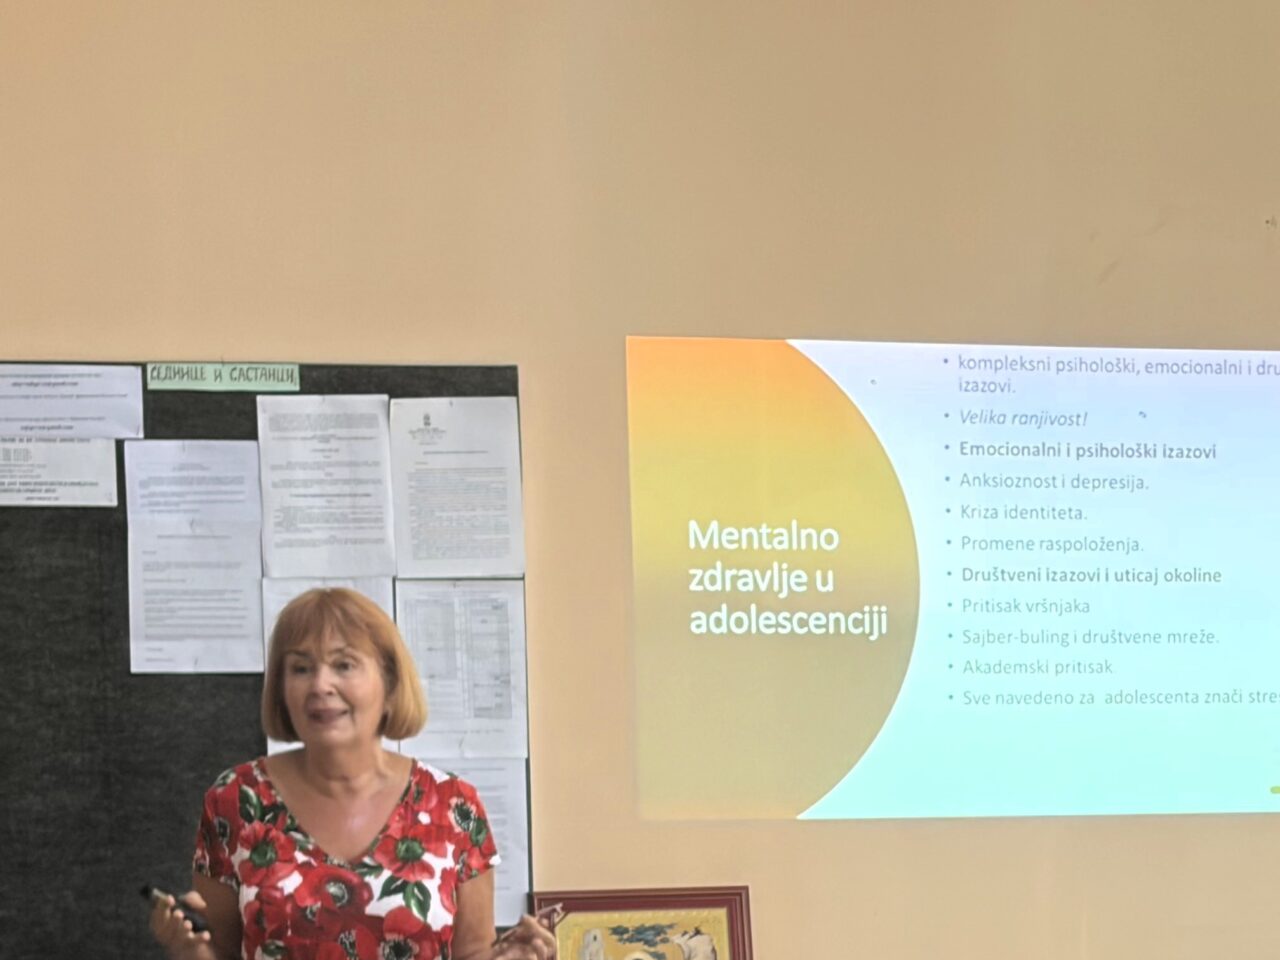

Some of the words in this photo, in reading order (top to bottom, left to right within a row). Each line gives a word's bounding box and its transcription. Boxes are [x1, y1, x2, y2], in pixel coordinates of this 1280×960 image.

[958, 355, 1051, 373] kompleksni
[1056, 357, 1141, 375] psihološki,
[1145, 360, 1242, 375] emocionalni
[1247, 360, 1252, 375] i
[958, 378, 1016, 394] izazovi.
[960, 410, 1007, 426] Velika
[1011, 411, 1088, 429] ranjivost!
[960, 441, 1061, 457] Emocionalni
[1066, 442, 1071, 457] i
[1076, 443, 1157, 461] psihološki
[1162, 444, 1216, 459] izazovi
[960, 473, 1057, 489] Anksioznost
[1062, 475, 1065, 489] i
[1071, 474, 1149, 492] depresija.
[961, 505, 998, 520] Kriza
[1003, 505, 1087, 521] identiteta.
[688, 519, 839, 551] Mentalno
[961, 536, 1035, 552] Promene
[1040, 536, 1144, 554] raspoloženja.
[688, 560, 808, 599] zdravlje
[816, 569, 834, 592] u
[962, 567, 1042, 583] Društveni
[1046, 567, 1101, 583] izazovi
[1105, 568, 1109, 583] i
[1114, 568, 1159, 585] uticaj
[1164, 569, 1222, 583] okoline
[962, 598, 1022, 613] Pritisak
[1026, 598, 1090, 616] vršnjaka
[690, 603, 888, 641] adolescenciji
[962, 629, 1070, 647] Sajber-buling
[1074, 630, 1078, 644] i
[1082, 629, 1162, 644] društvene
[1167, 630, 1220, 644] mreže.
[963, 660, 1049, 674] Akademski
[1055, 660, 1113, 678] pritisak
[963, 691, 991, 705] Sve
[996, 690, 1074, 705] navedeno
[1079, 693, 1095, 705] za
[1105, 689, 1199, 704] adolescenta
[1204, 689, 1243, 704] znači
